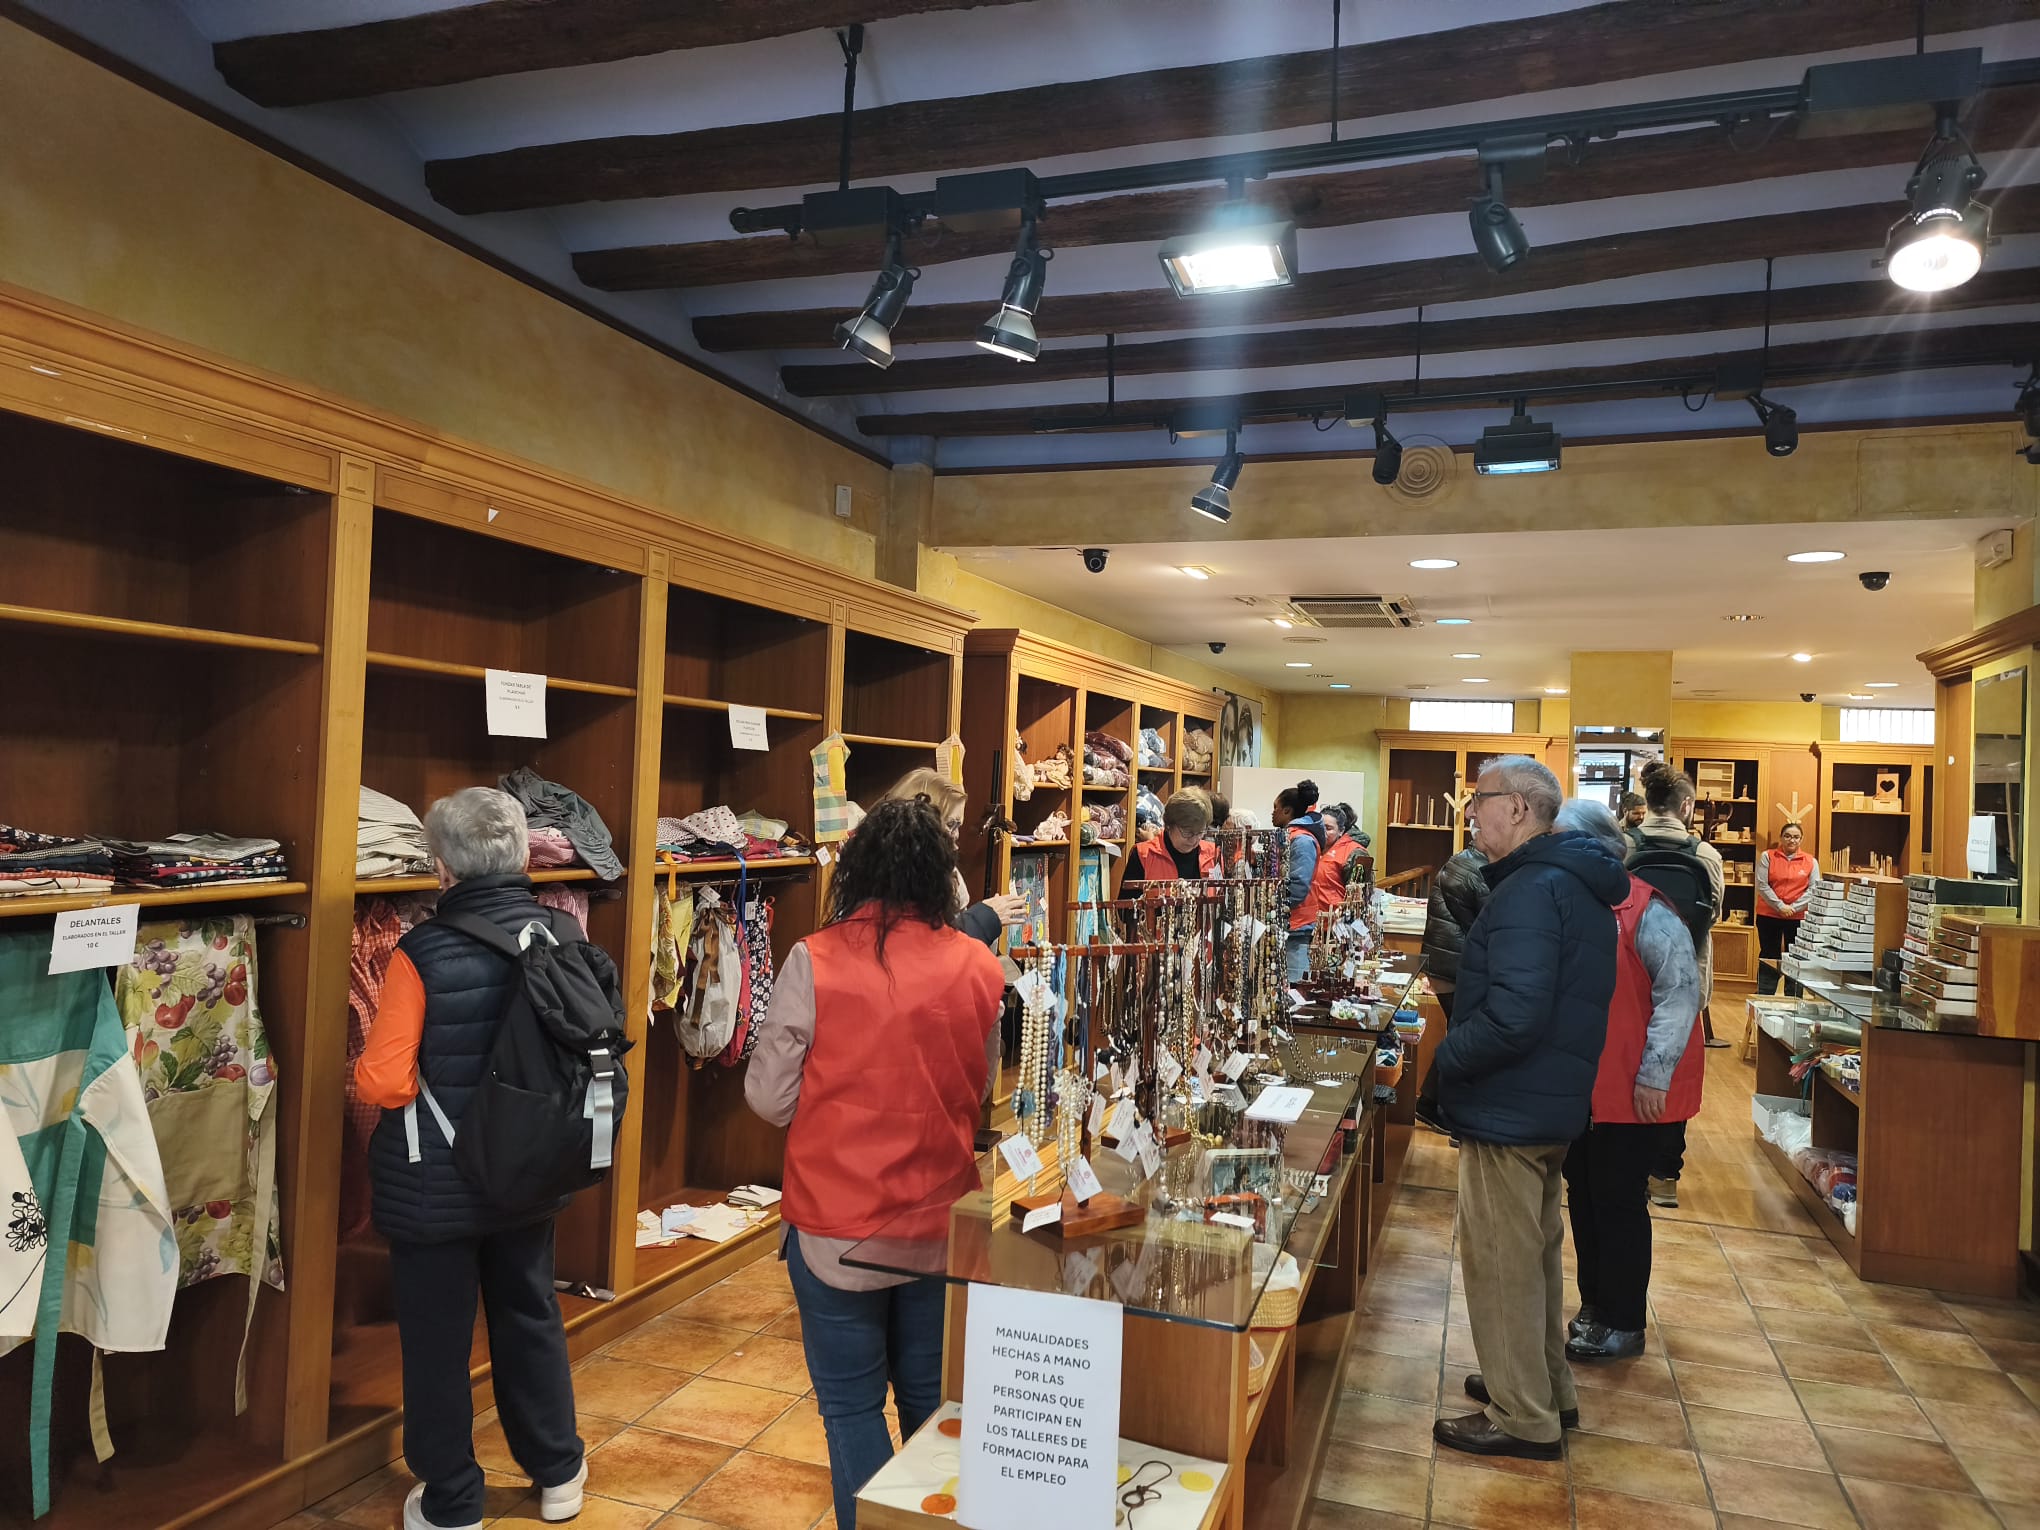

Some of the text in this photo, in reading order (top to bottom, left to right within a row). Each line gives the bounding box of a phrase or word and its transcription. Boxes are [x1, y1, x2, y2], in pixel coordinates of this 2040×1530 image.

[70, 917, 122, 928] DELANTALES
[62, 932, 94, 941] ELABORADOS
[996, 1326, 1089, 1350] MANUALIDADES
[992, 1346, 1091, 1370] HECHAS A MANO
[1015, 1369, 1064, 1386] POR LAS
[993, 1385, 1085, 1409] PERSONAS QUE
[993, 1405, 1082, 1428] PARTICIPAN EN
[986, 1423, 1088, 1449] LOS TALLERES DE
[982, 1442, 1089, 1469] FORMACION PARA
[1001, 1466, 1067, 1486] EL EMPLEO
